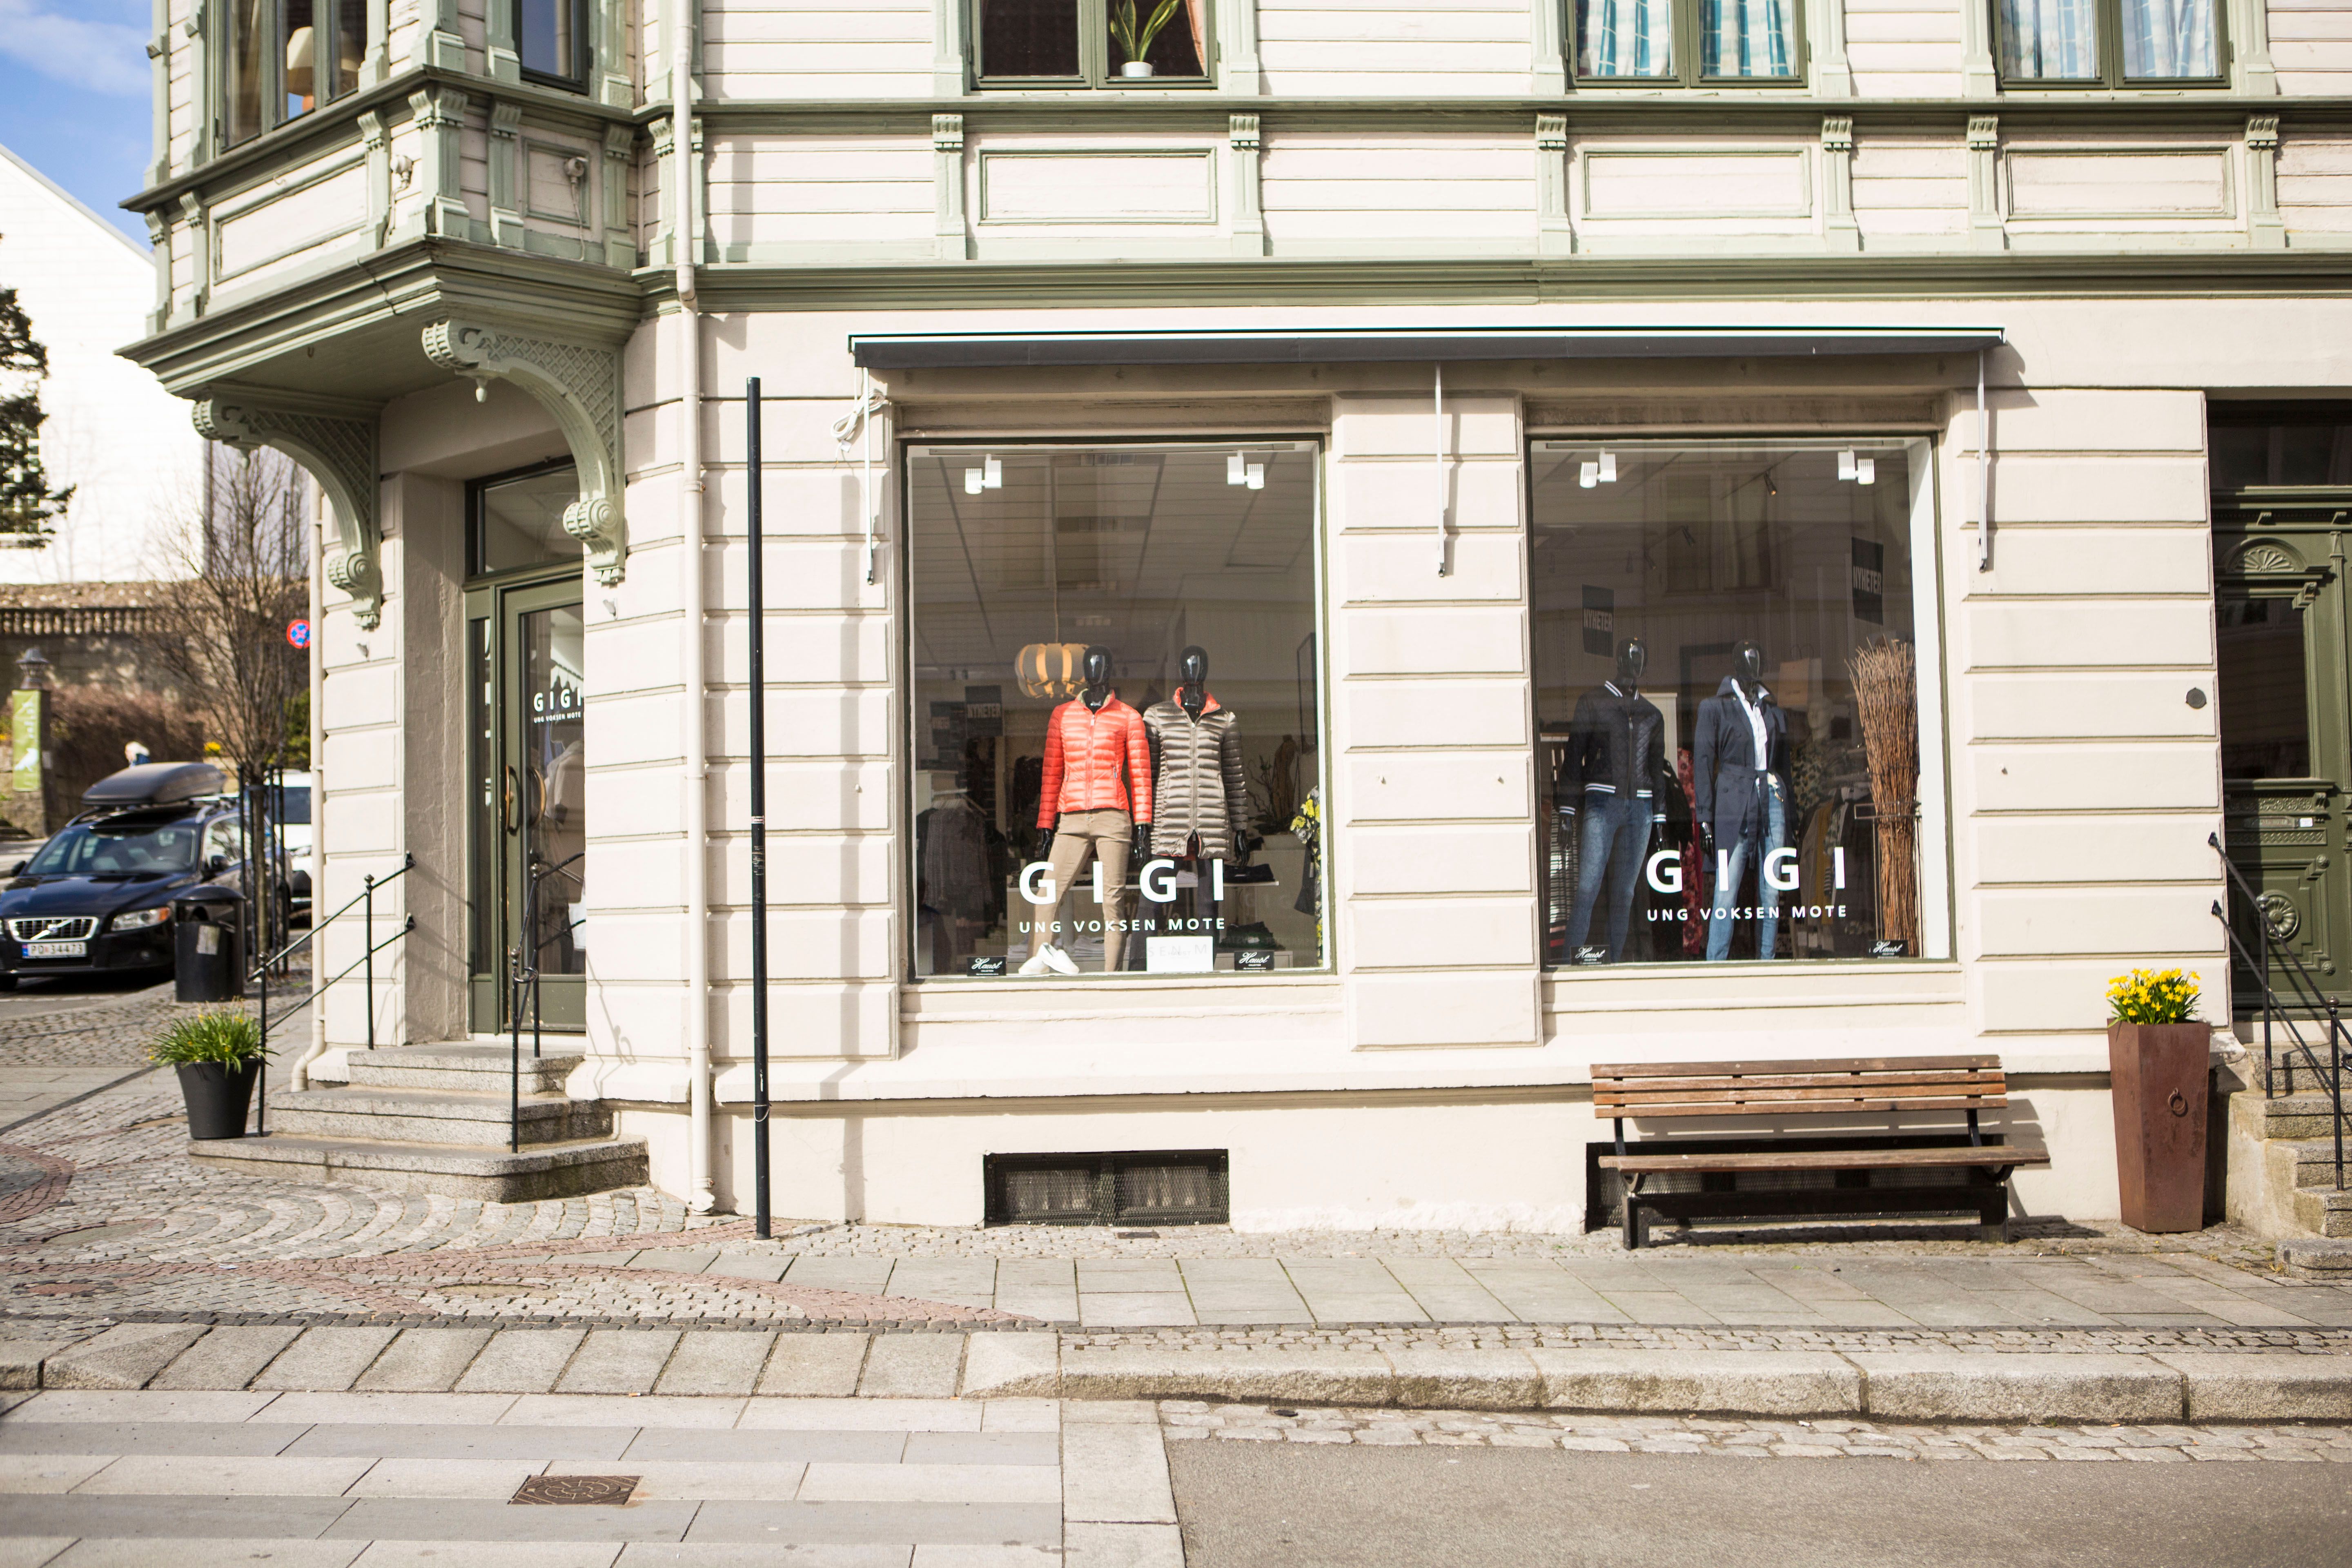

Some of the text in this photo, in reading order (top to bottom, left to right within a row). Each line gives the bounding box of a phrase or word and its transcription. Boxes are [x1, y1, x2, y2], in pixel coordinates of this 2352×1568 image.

[1853, 566, 1882, 595] NYHETER
[1584, 608, 1613, 632] NYHETER
[534, 688, 581, 712] GIGI
[546, 714, 566, 722] VOKSEN
[1647, 847, 1845, 893] GIGI
[1019, 859, 1224, 904] GIGI
[1647, 905, 1846, 921] UNG VOKSEN MOTE
[1020, 918, 1225, 933] UNG VOKSEN MOTE
[51, 944, 83, 954] 34473
[971, 958, 1003, 969] Haust
[1239, 952, 1270, 964] Haust
